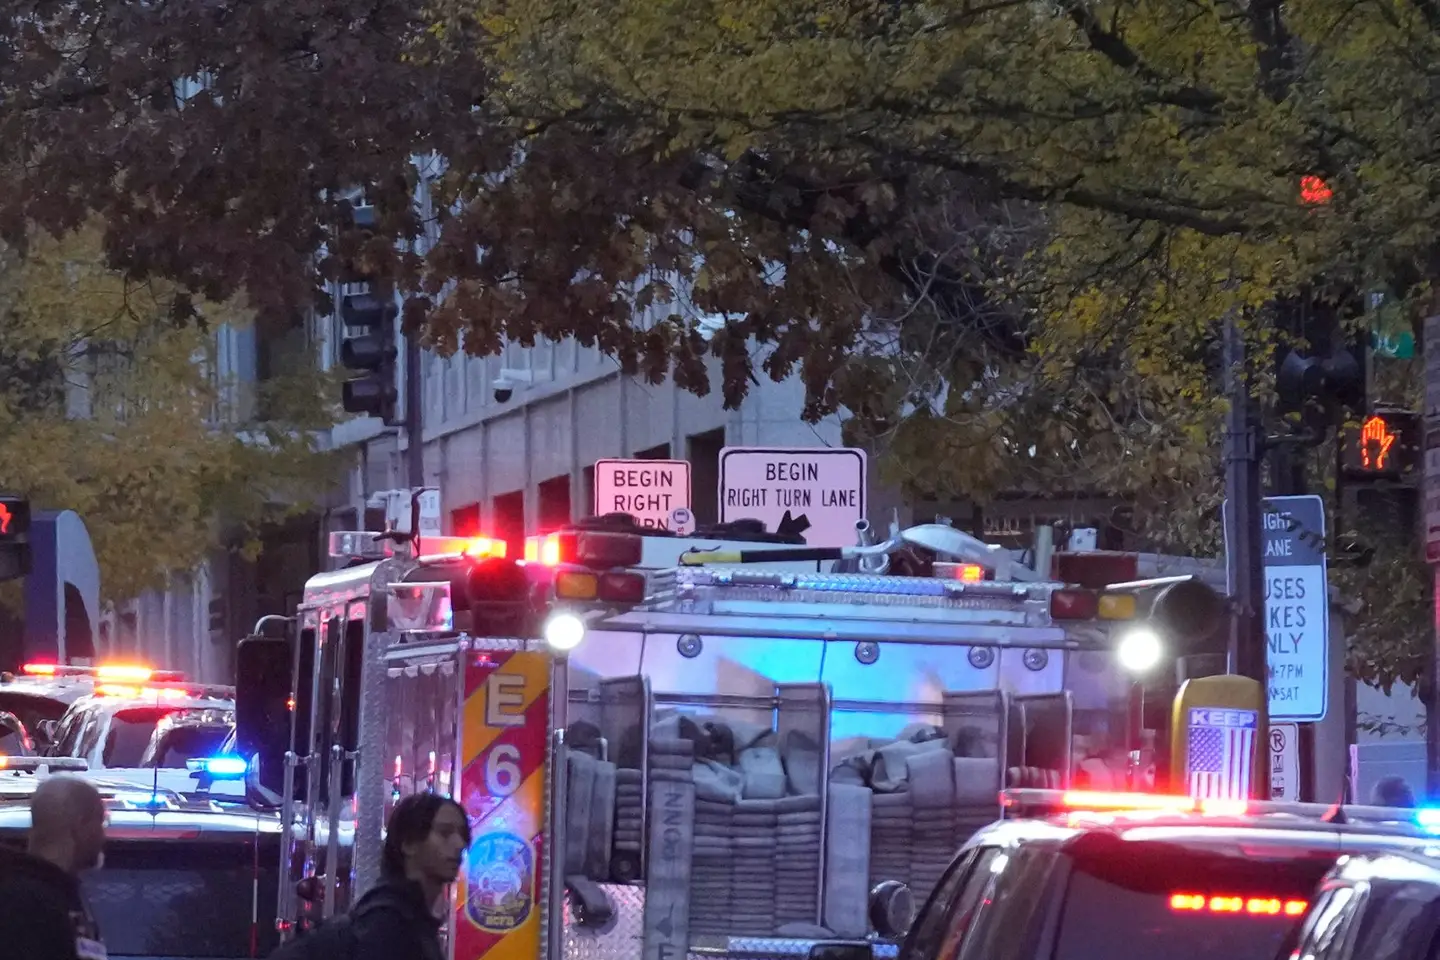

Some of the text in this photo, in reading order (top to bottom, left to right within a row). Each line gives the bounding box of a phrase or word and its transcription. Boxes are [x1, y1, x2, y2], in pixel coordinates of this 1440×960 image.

[614, 470, 672, 487] BEGIN
[766, 462, 818, 481] BEGIN
[614, 494, 672, 511] RIGHT
[728, 488, 856, 507] RIGHT TURN LANE
[1263, 512, 1292, 530] IGHT
[1265, 539, 1293, 556] ANE
[1270, 606, 1306, 628] KES
[1267, 632, 1304, 653] NLY
[1191, 711, 1255, 726] KEEP
